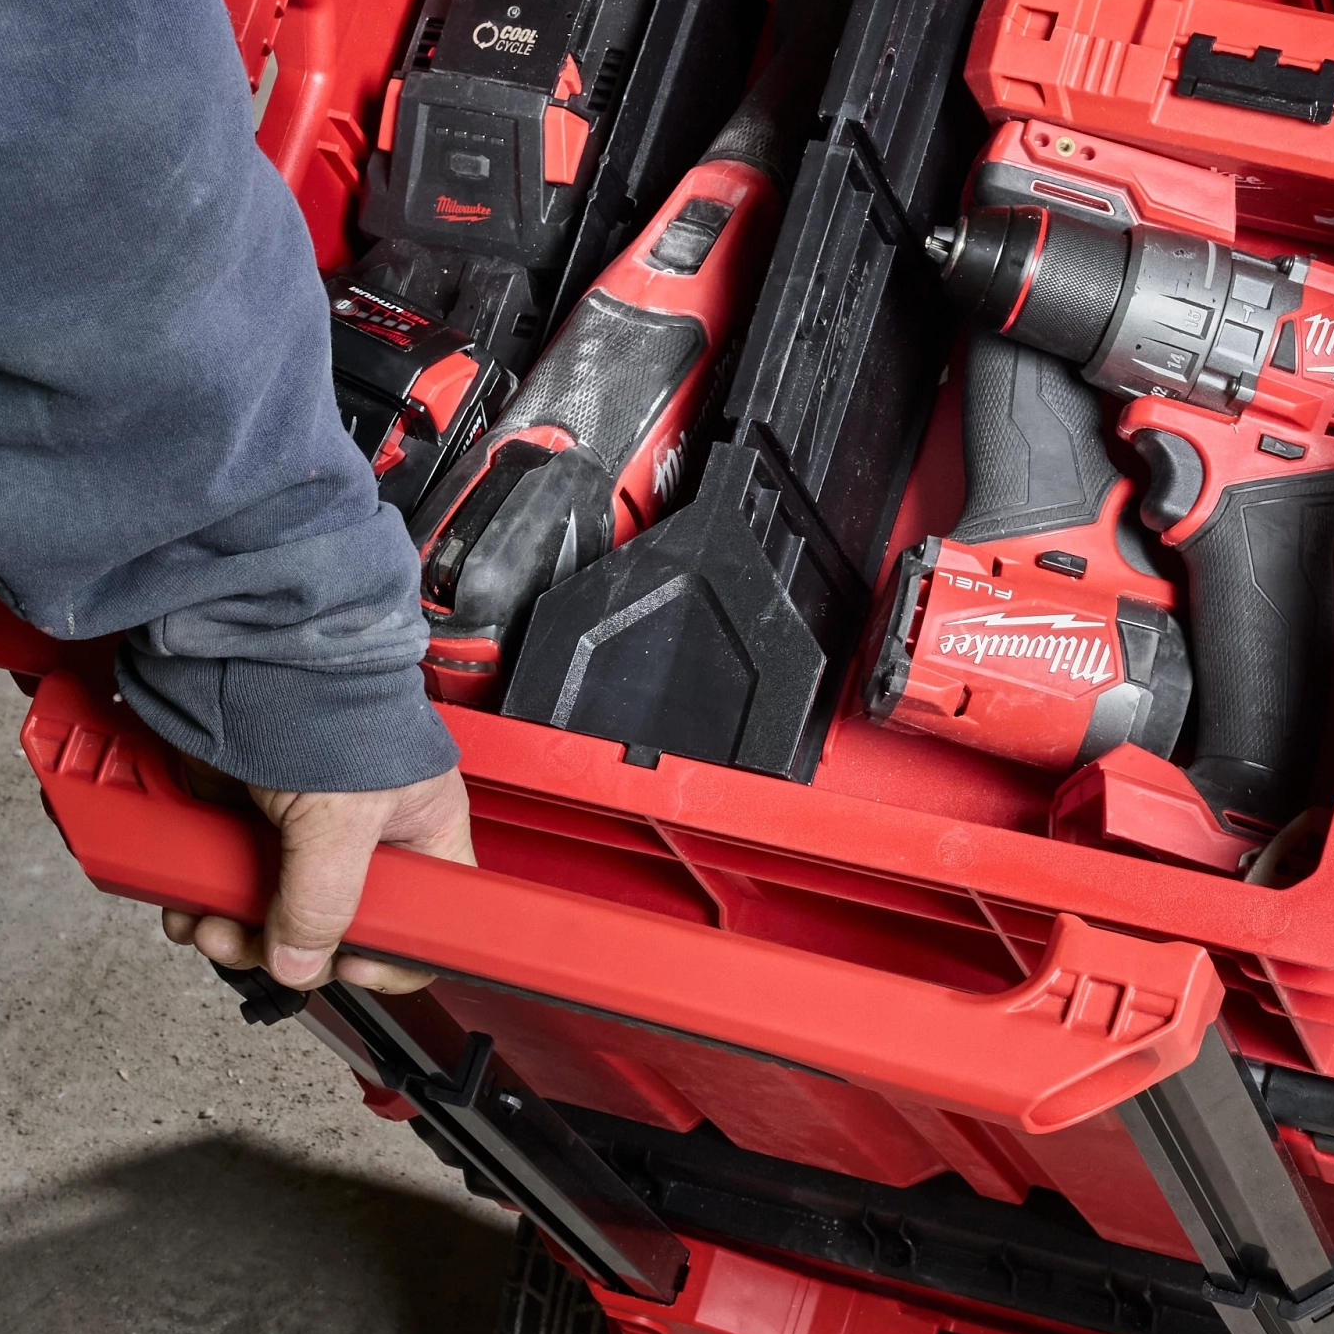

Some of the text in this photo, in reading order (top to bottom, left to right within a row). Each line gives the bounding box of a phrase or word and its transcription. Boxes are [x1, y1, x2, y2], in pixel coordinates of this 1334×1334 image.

[499, 25, 537, 44] COOL
[495, 39, 534, 56] CYCLE
[436, 195, 492, 215] Milwaukee
[348, 285, 430, 326] REDLITHIUM
[1185, 310, 1201, 328] 16
[1167, 352, 1186, 369] 14
[938, 571, 1012, 600] FUEL
[939, 633, 1113, 685] Milwaukee
